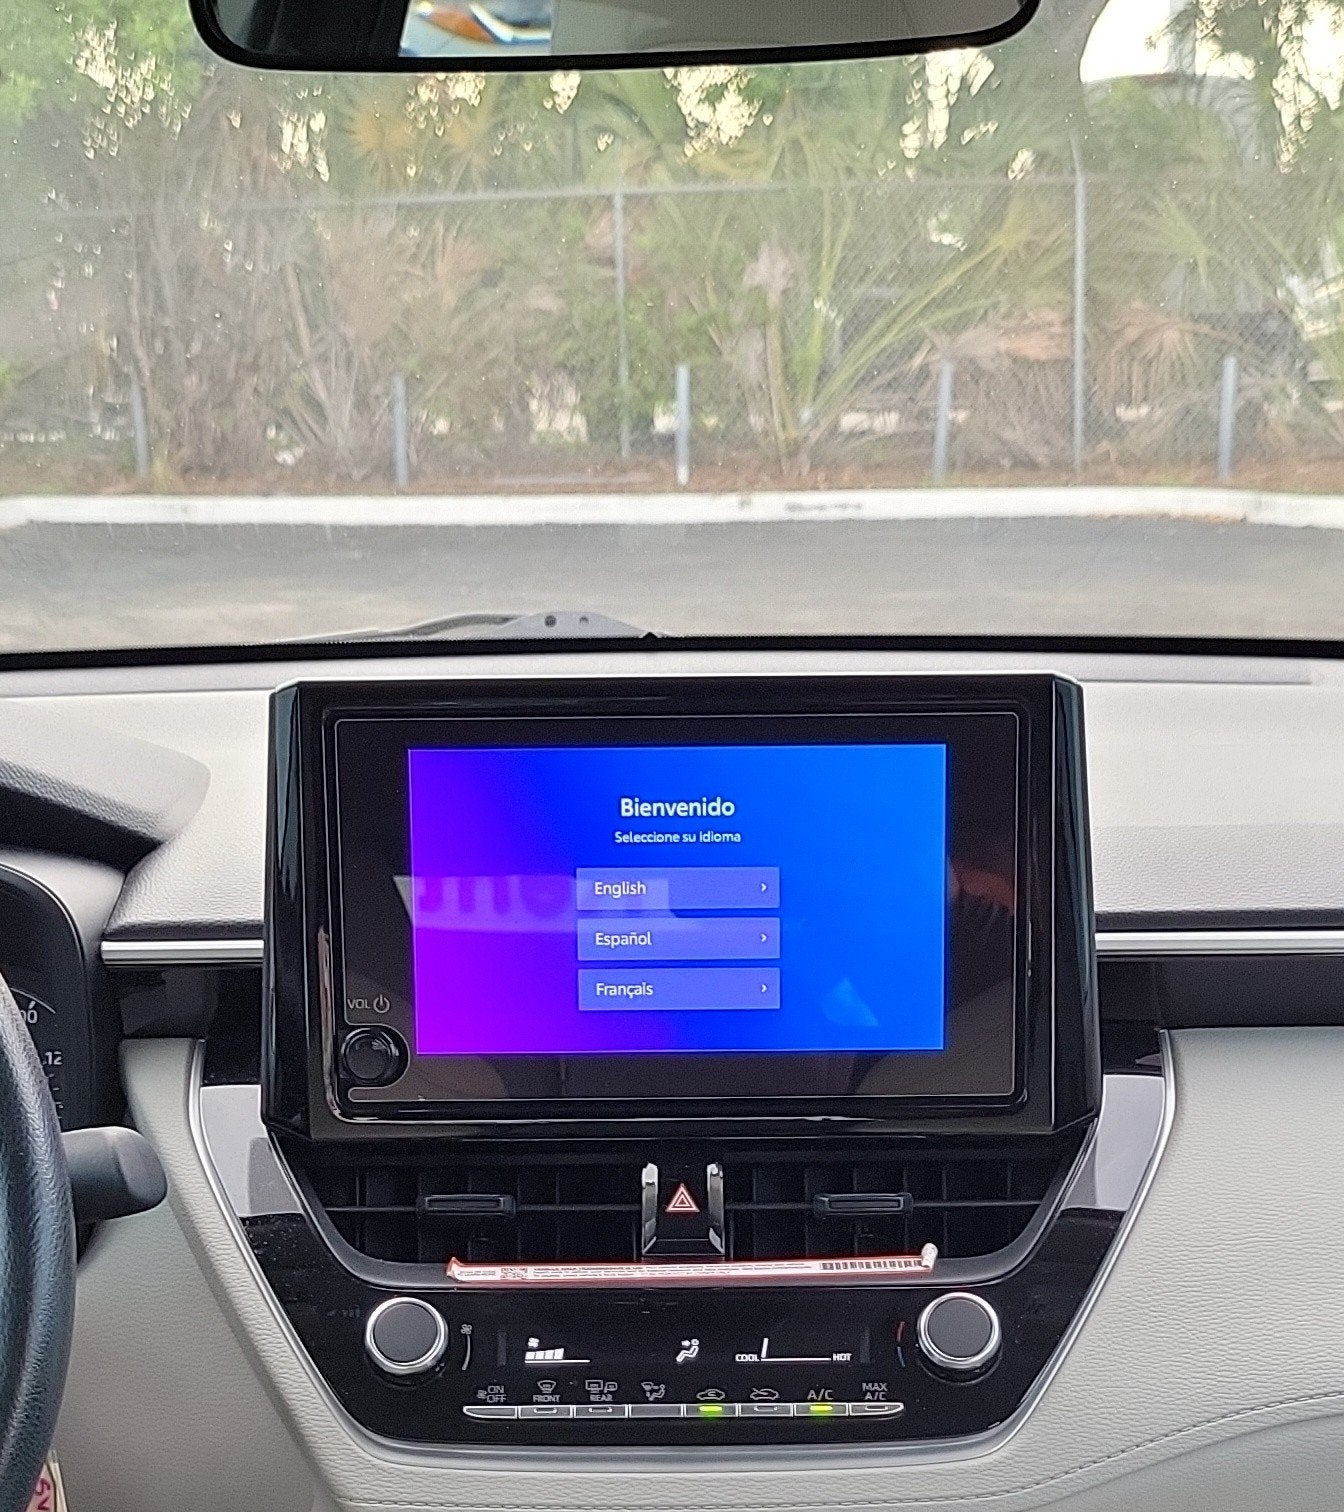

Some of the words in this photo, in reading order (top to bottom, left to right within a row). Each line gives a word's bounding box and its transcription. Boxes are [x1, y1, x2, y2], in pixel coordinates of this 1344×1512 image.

[620, 796, 736, 817] Bienvenido
[614, 831, 680, 843] Seleccione
[682, 833, 696, 843] su
[699, 831, 741, 843] idioma
[594, 881, 647, 899] English
[595, 931, 653, 949] Español
[596, 982, 654, 999] Français
[347, 998, 371, 1009] VOL
[734, 1354, 760, 1362] COOL
[832, 1353, 853, 1362] HOT
[487, 1385, 505, 1394] ON
[861, 1382, 888, 1392] MAX
[486, 1395, 506, 1403] OFF
[532, 1394, 561, 1403] FRONT
[589, 1394, 613, 1402] REAR
[806, 1388, 834, 1401] A/C
[864, 1392, 887, 1401] A/C
